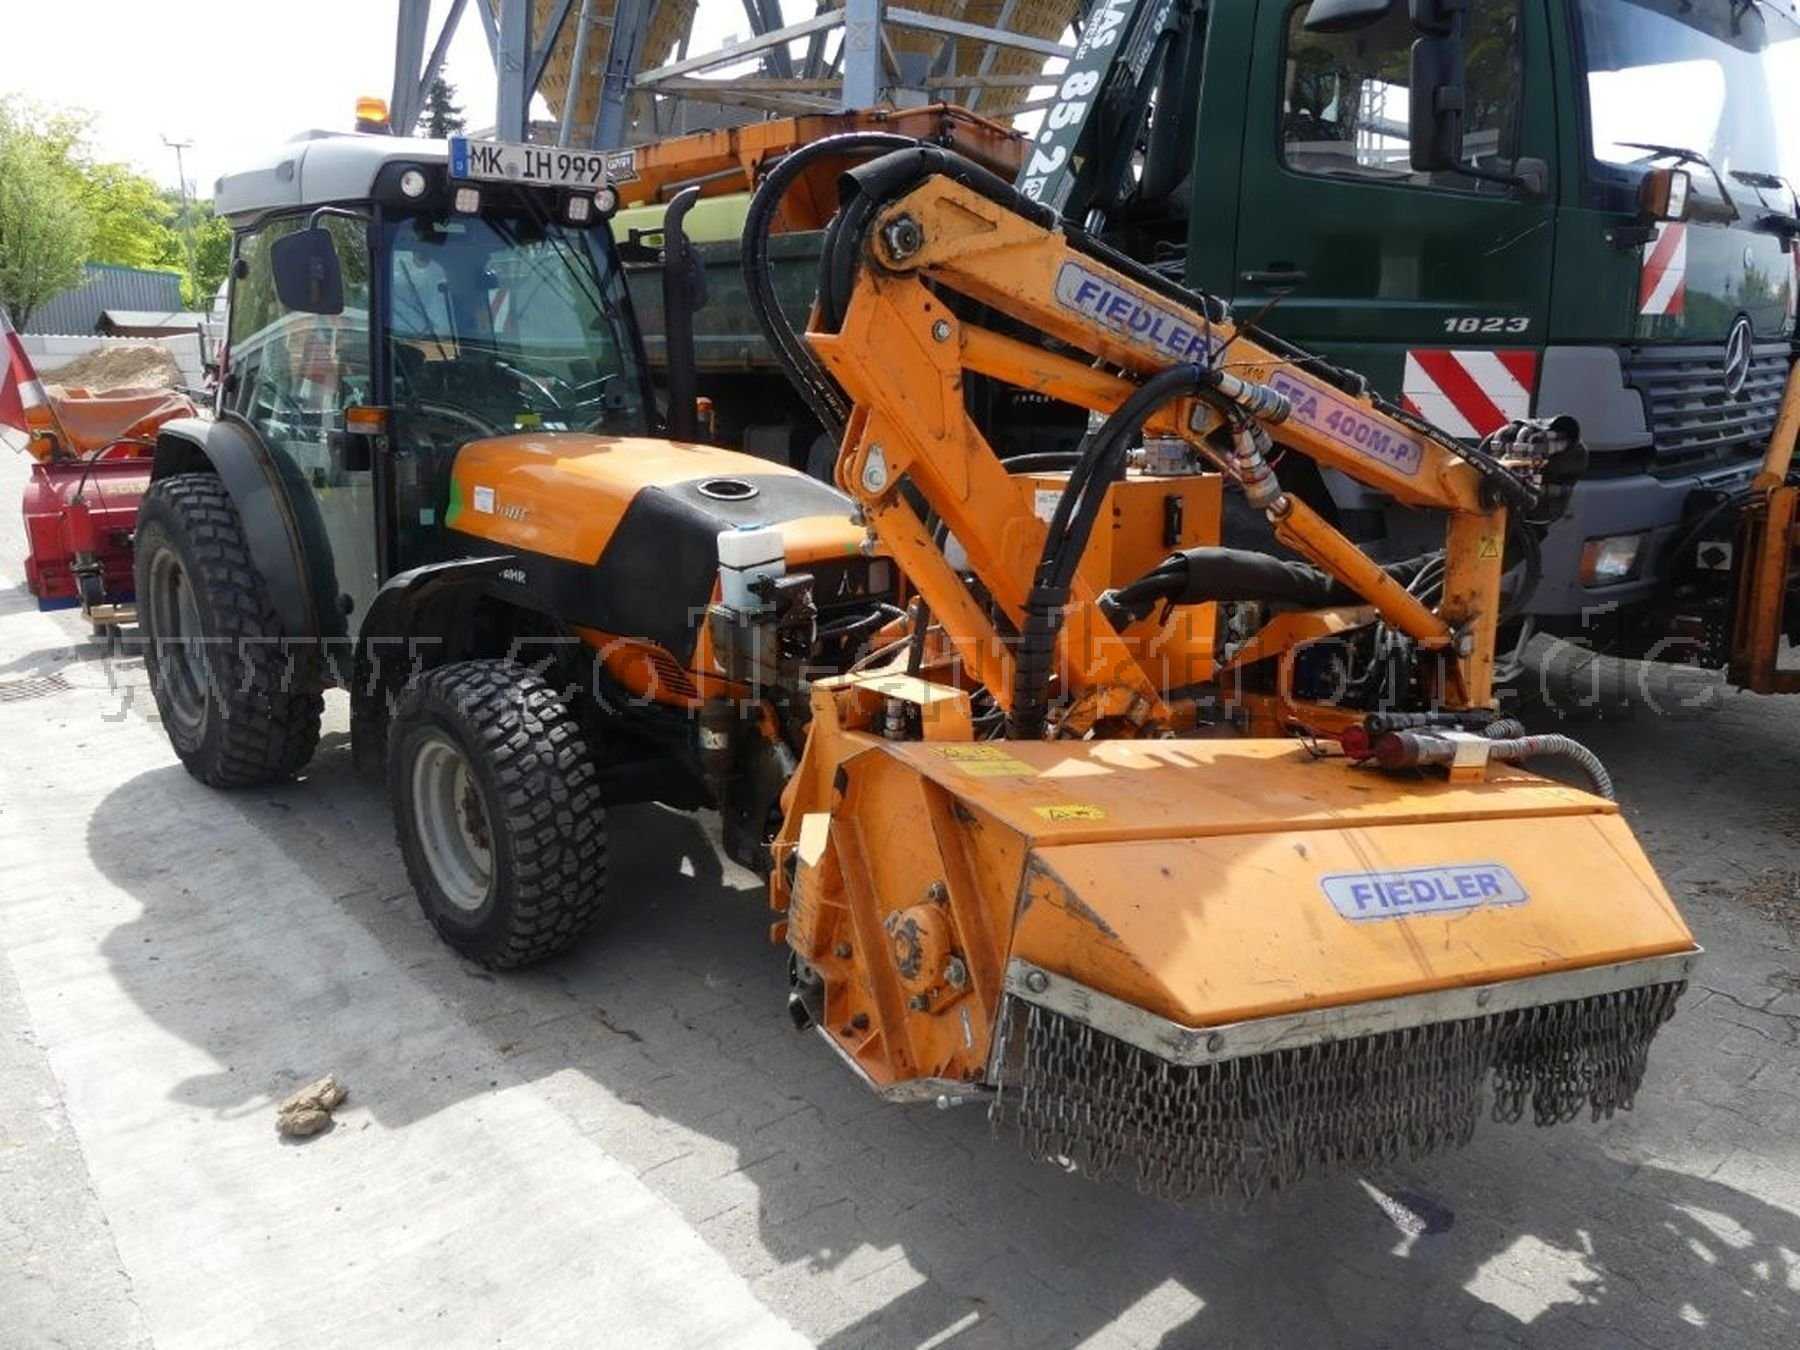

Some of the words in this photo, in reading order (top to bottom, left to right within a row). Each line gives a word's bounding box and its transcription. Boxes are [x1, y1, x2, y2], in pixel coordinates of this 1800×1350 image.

[1026, 70, 1100, 177] 85.2
[471, 146, 504, 175] MK
[523, 150, 552, 179] IH
[558, 154, 602, 183] 999
[1074, 279, 1210, 360] FIEDLER
[1443, 317, 1530, 333] 1823
[499, 568, 527, 585] AHR
[1350, 872, 1503, 911] FIEDLER
